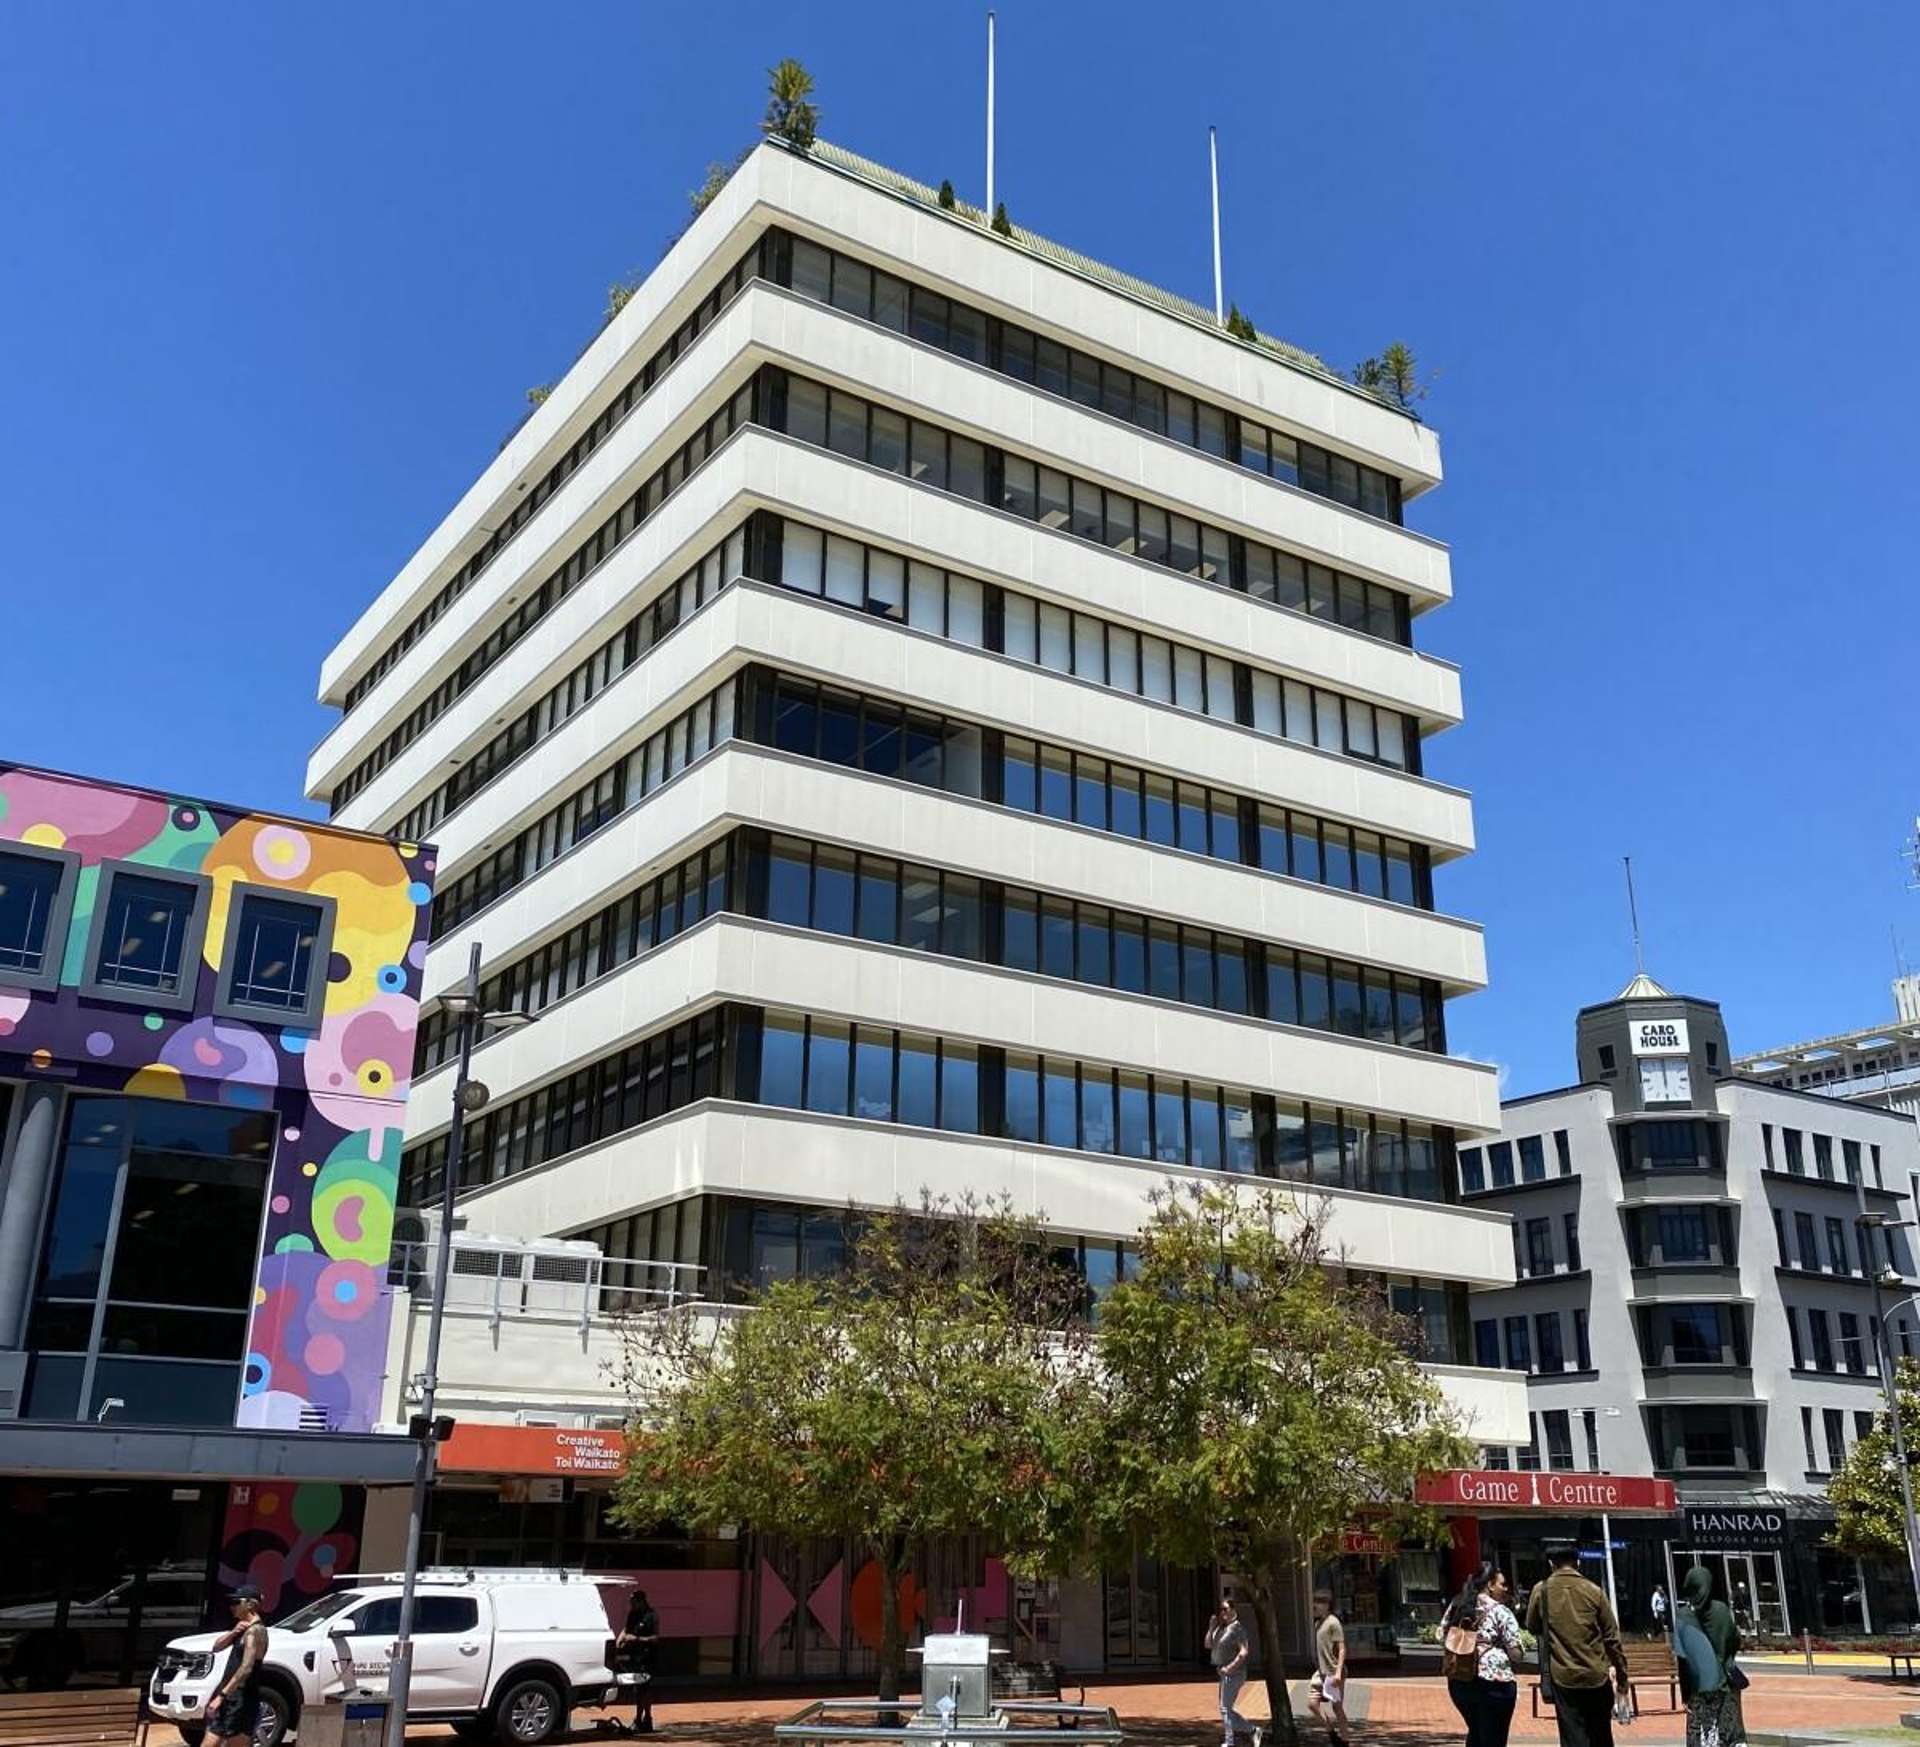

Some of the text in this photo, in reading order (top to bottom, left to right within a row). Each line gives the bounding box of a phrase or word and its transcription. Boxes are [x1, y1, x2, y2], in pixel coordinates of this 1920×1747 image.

[1642, 1025, 1675, 1036] CARO
[1640, 1035, 1681, 1047] HOUSE
[556, 1434, 605, 1446] Creative
[575, 1446, 621, 1459] Waikato
[555, 1456, 620, 1470] Toi Waikato
[1460, 1473, 1617, 1504] Game Centre
[1692, 1514, 1781, 1531] HANRAD
